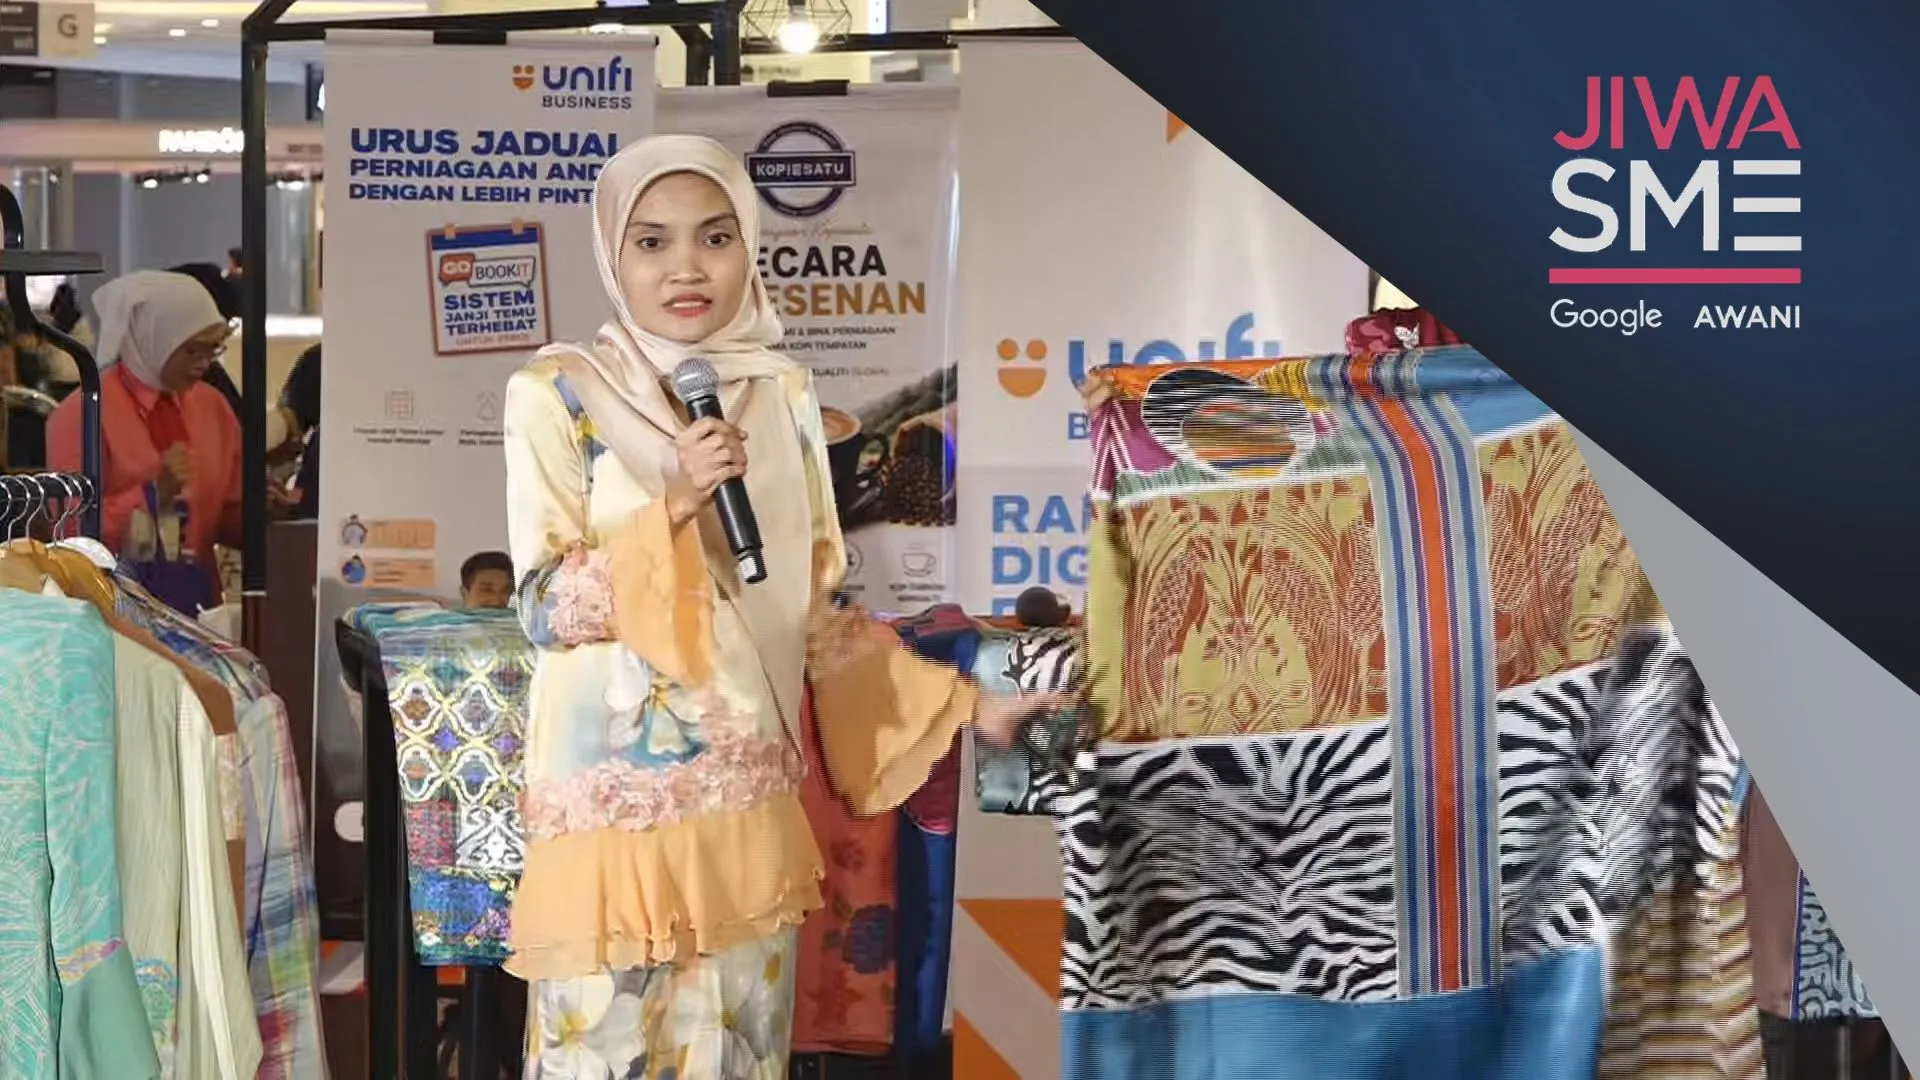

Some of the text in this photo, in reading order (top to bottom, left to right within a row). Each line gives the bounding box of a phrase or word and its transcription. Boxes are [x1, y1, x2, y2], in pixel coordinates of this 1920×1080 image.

[543, 55, 632, 91] unifi
[542, 95, 632, 109] BUSINESS
[351, 128, 459, 153] URUS
[350, 159, 604, 181] PERNIAGAAN AND
[349, 184, 594, 204] DENGAN LEBIH PINT
[757, 244, 887, 278] ECARA
[444, 290, 535, 310] SISTEM
[766, 281, 926, 317] SENAN
[445, 307, 536, 323] JANJI TEMU
[445, 319, 537, 336] TERHEBAT
[815, 340, 868, 350] TEMPATAN
[992, 545, 1088, 585] DIG
